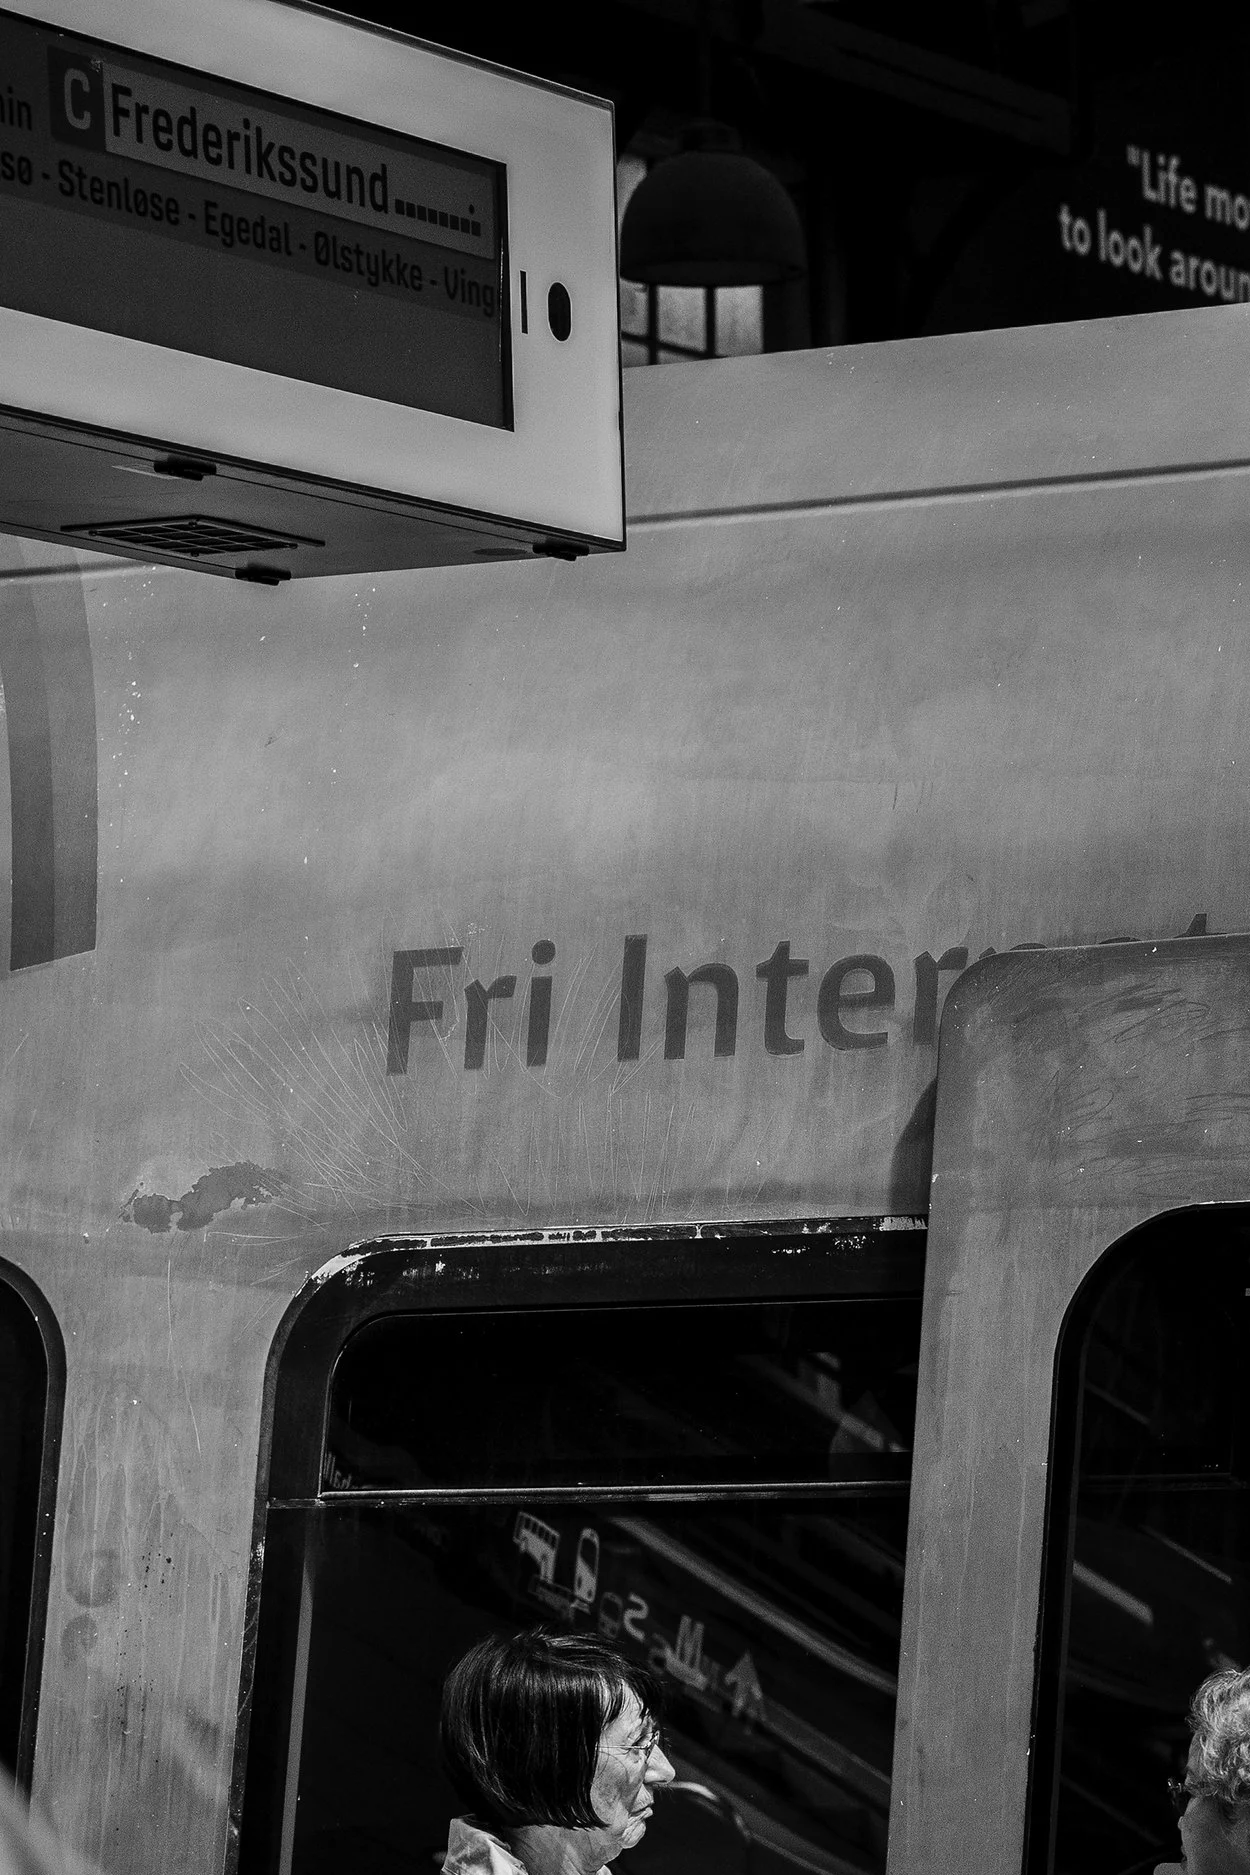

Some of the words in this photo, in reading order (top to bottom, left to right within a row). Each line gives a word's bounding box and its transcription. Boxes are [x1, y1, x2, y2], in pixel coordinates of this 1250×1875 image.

[63, 67, 92, 131] C
[110, 83, 390, 215] Frederikssund
[58, 159, 180, 226] Stenløse
[204, 199, 293, 256] Egedal
[314, 230, 423, 293] Ølstykke
[1058, 203, 1091, 256] to
[1097, 208, 1163, 281] look
[386, 939, 557, 1076] Fri
[617, 930, 1055, 1063] Inter
